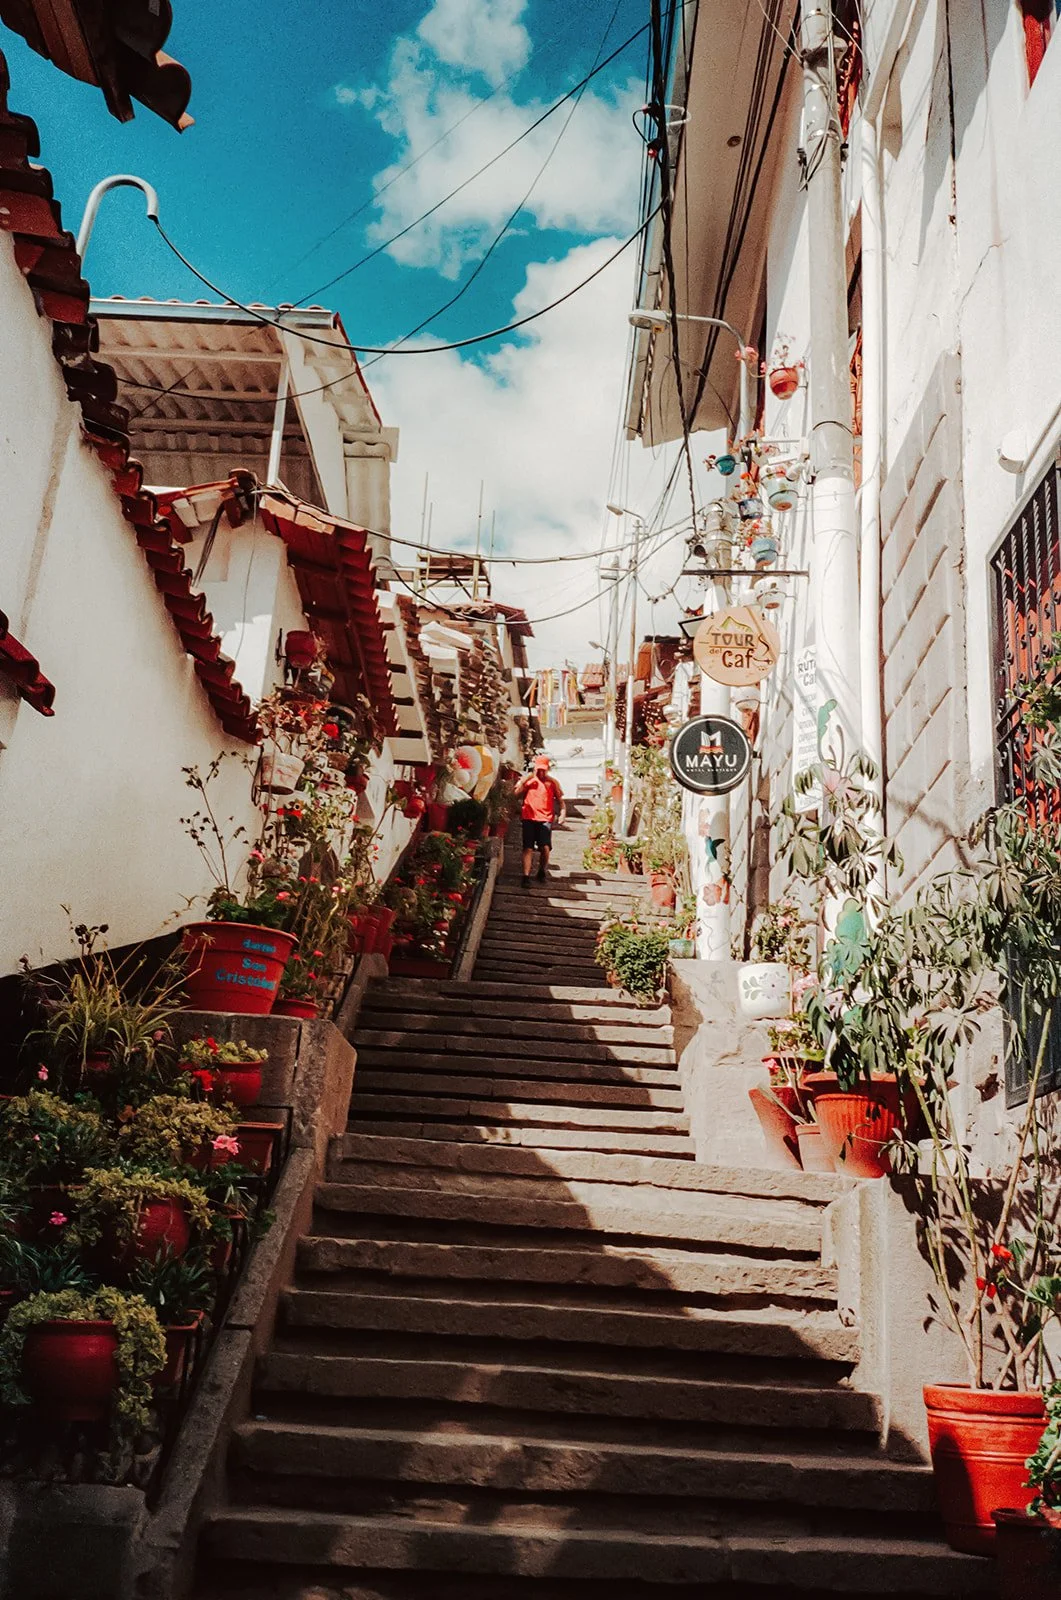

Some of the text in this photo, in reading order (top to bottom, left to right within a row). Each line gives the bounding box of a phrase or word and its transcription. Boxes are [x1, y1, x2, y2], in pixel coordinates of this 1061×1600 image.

[711, 633, 755, 647] TOUR
[798, 659, 817, 673] RUT
[685, 754, 738, 768] MAYU
